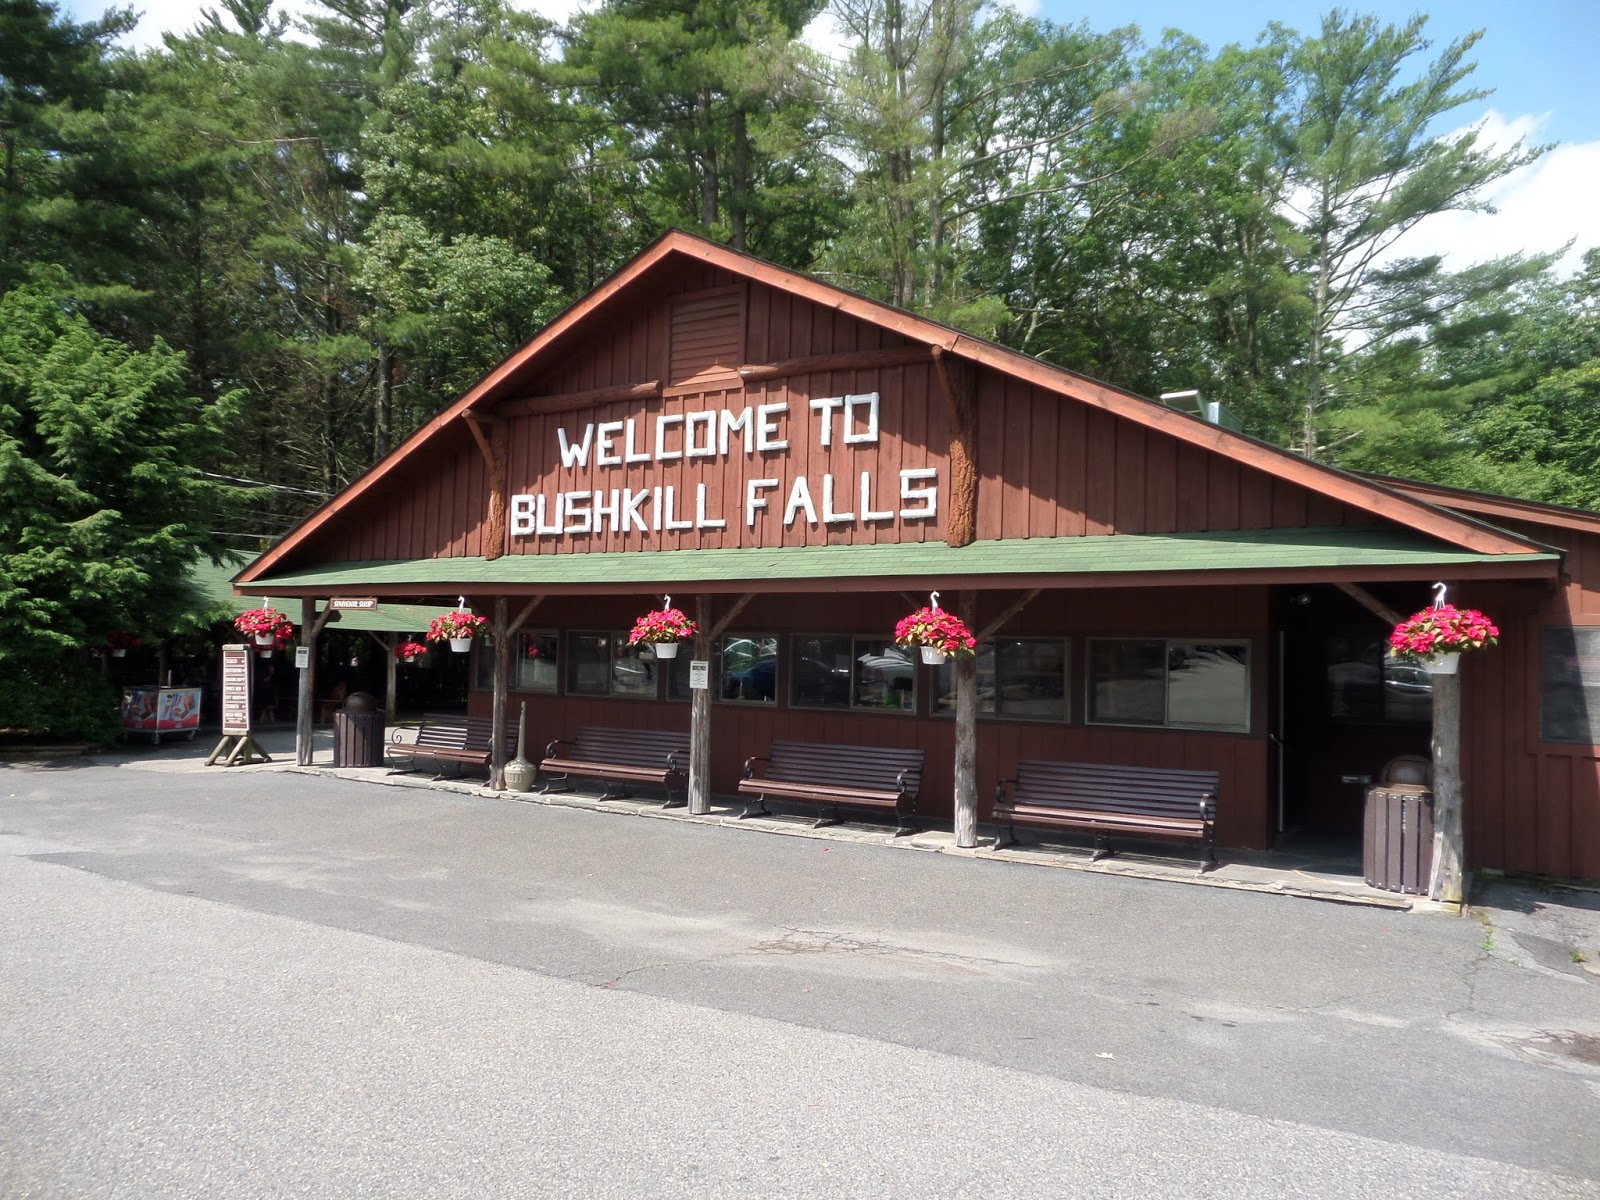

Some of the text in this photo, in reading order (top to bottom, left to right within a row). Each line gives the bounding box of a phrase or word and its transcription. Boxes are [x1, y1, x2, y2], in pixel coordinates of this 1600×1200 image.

[556, 391, 880, 468] WELCOME TO
[509, 467, 938, 536] BUSHKILL FALLS
[358, 600, 374, 608] SHOP
